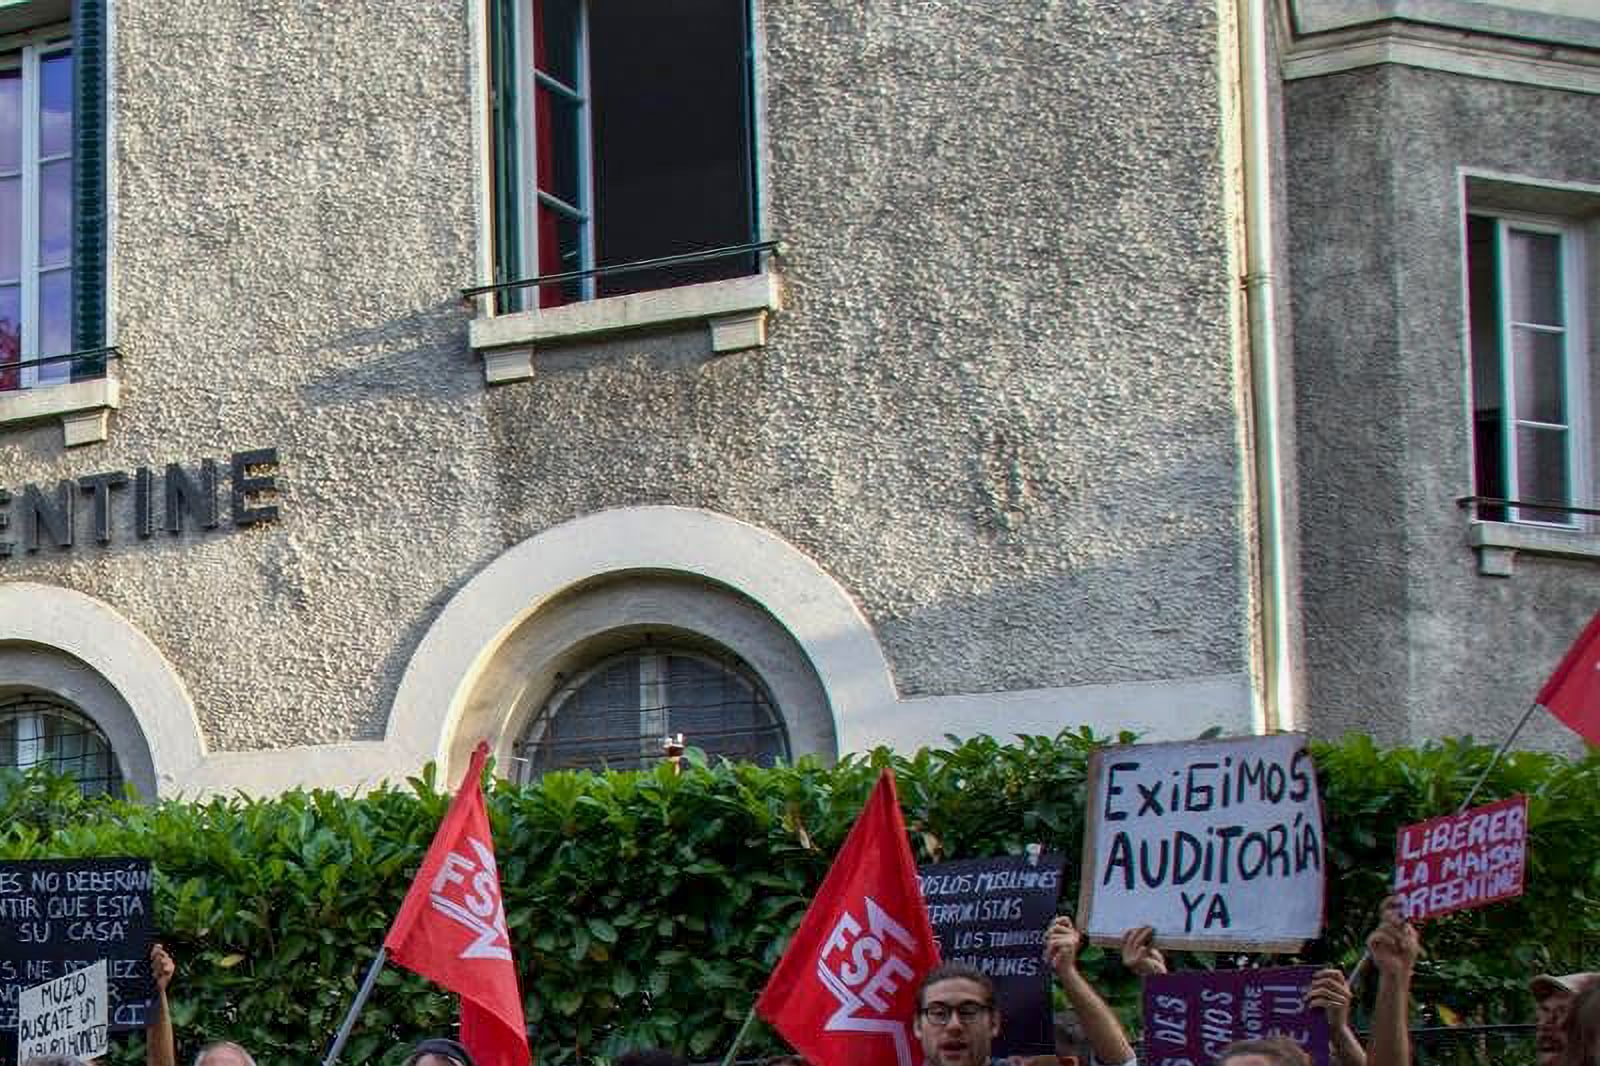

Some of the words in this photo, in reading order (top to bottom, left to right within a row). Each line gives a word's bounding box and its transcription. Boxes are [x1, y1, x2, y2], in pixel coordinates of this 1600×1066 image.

[32, 871, 59, 893] NO
[1394, 862, 1429, 890] LA
[48, 896, 90, 919] QUE
[1180, 892, 1231, 933] YA
[18, 922, 49, 943] SU
[41, 973, 87, 1007] MUZIO
[1154, 994, 1187, 1046] DES
